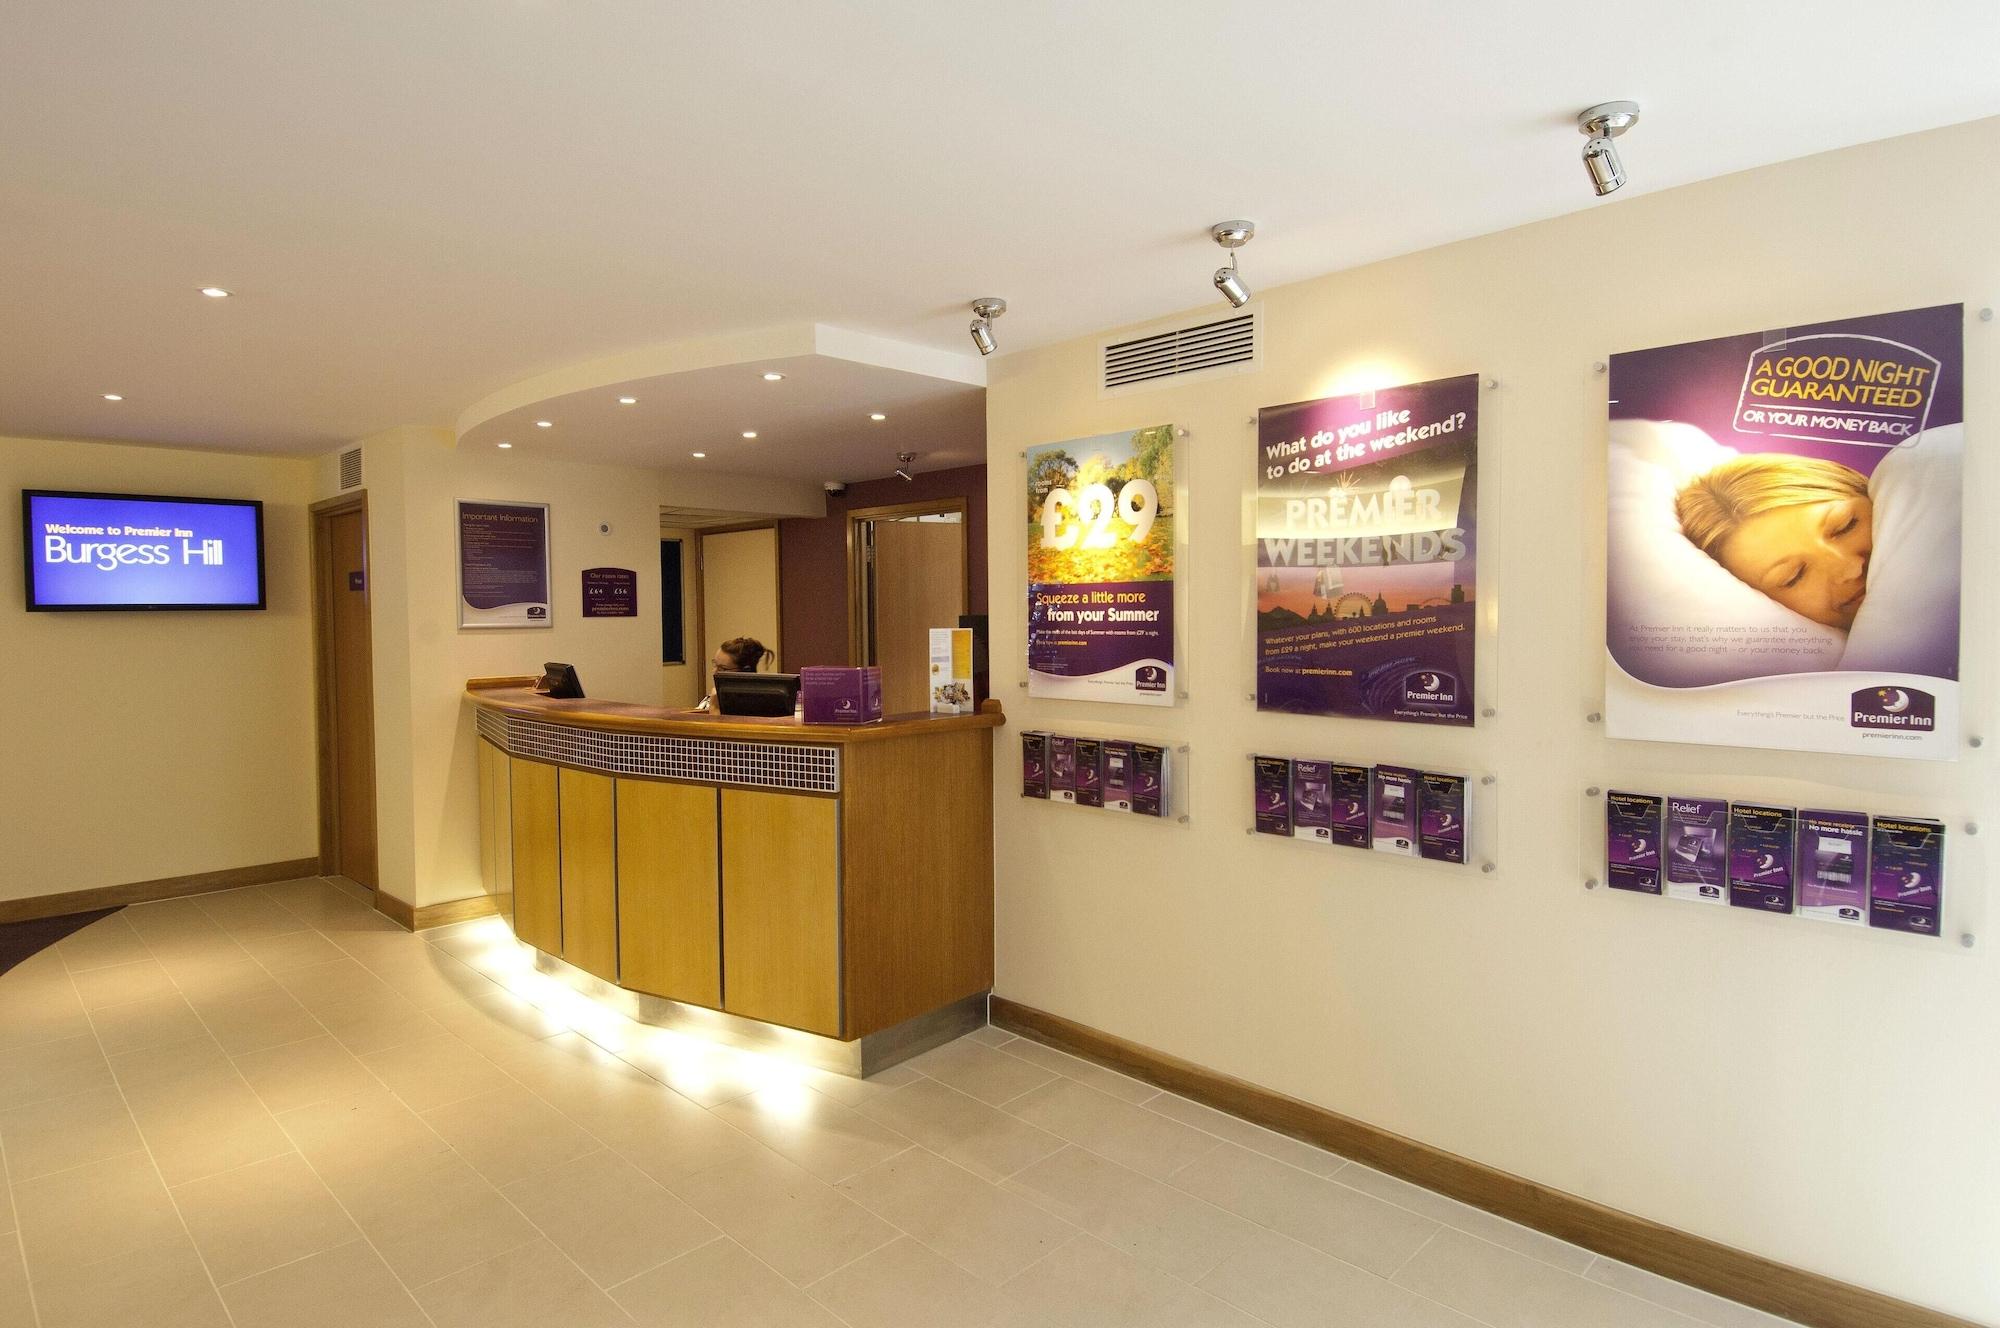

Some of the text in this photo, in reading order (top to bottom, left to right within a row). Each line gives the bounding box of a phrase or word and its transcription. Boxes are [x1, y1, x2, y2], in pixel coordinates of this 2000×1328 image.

[1756, 356, 1930, 386] A GOOD NIGHT
[1751, 378, 1922, 408] GUARANTEED
[1743, 410, 1914, 436] OR YOUR MONEY BACK
[1266, 409, 1410, 460] What do you like
[1267, 411, 1467, 480] to do at the weekend?
[1040, 478, 1159, 551] £29
[1286, 489, 1442, 530] PREMIER
[462, 512, 538, 523] Important Information
[45, 523, 193, 538] Welcome to Premier Inn
[45, 535, 223, 571] Burgess Hill
[1263, 527, 1467, 567] WEEKENDS
[1036, 591, 1146, 605] Squeeze a little more
[1047, 607, 1159, 624] from your Summer
[1295, 633, 1310, 643] your
[1332, 627, 1347, 636] with
[1348, 625, 1361, 635] 600
[1363, 622, 1395, 632] locations
[1397, 618, 1411, 628] and
[1412, 616, 1437, 625] rooms
[1694, 626, 1713, 634] really
[1791, 627, 1807, 635] you
[1265, 647, 1280, 655] from
[1281, 645, 1293, 654] £29
[1319, 639, 1337, 649] make
[1338, 638, 1354, 648] your
[1355, 634, 1388, 645] weekend
[1396, 629, 1425, 641] premier
[1427, 624, 1466, 635] weekend.
[1711, 636, 1728, 644] why
[1746, 637, 1786, 645] guarantee
[1788, 637, 1833, 646] everything
[1750, 647, 1768, 655] your
[1771, 647, 1800, 655] money
[1265, 665, 1280, 673] Book
[1302, 667, 1353, 677] premierinn.com
[1136, 680, 1156, 688] Premier
[1407, 690, 1453, 701] Premier Inn
[1854, 711, 1932, 726] Premier Inn
[1862, 731, 1922, 741] premierinn.com
[1297, 763, 1317, 773] Relief
[1672, 802, 1702, 814] Relief
[1753, 808, 1783, 817] locations
[1820, 825, 1840, 834] more
[1840, 827, 1863, 836] hassle
[1877, 822, 1897, 830] Hotel
[1898, 824, 1932, 833] locations
